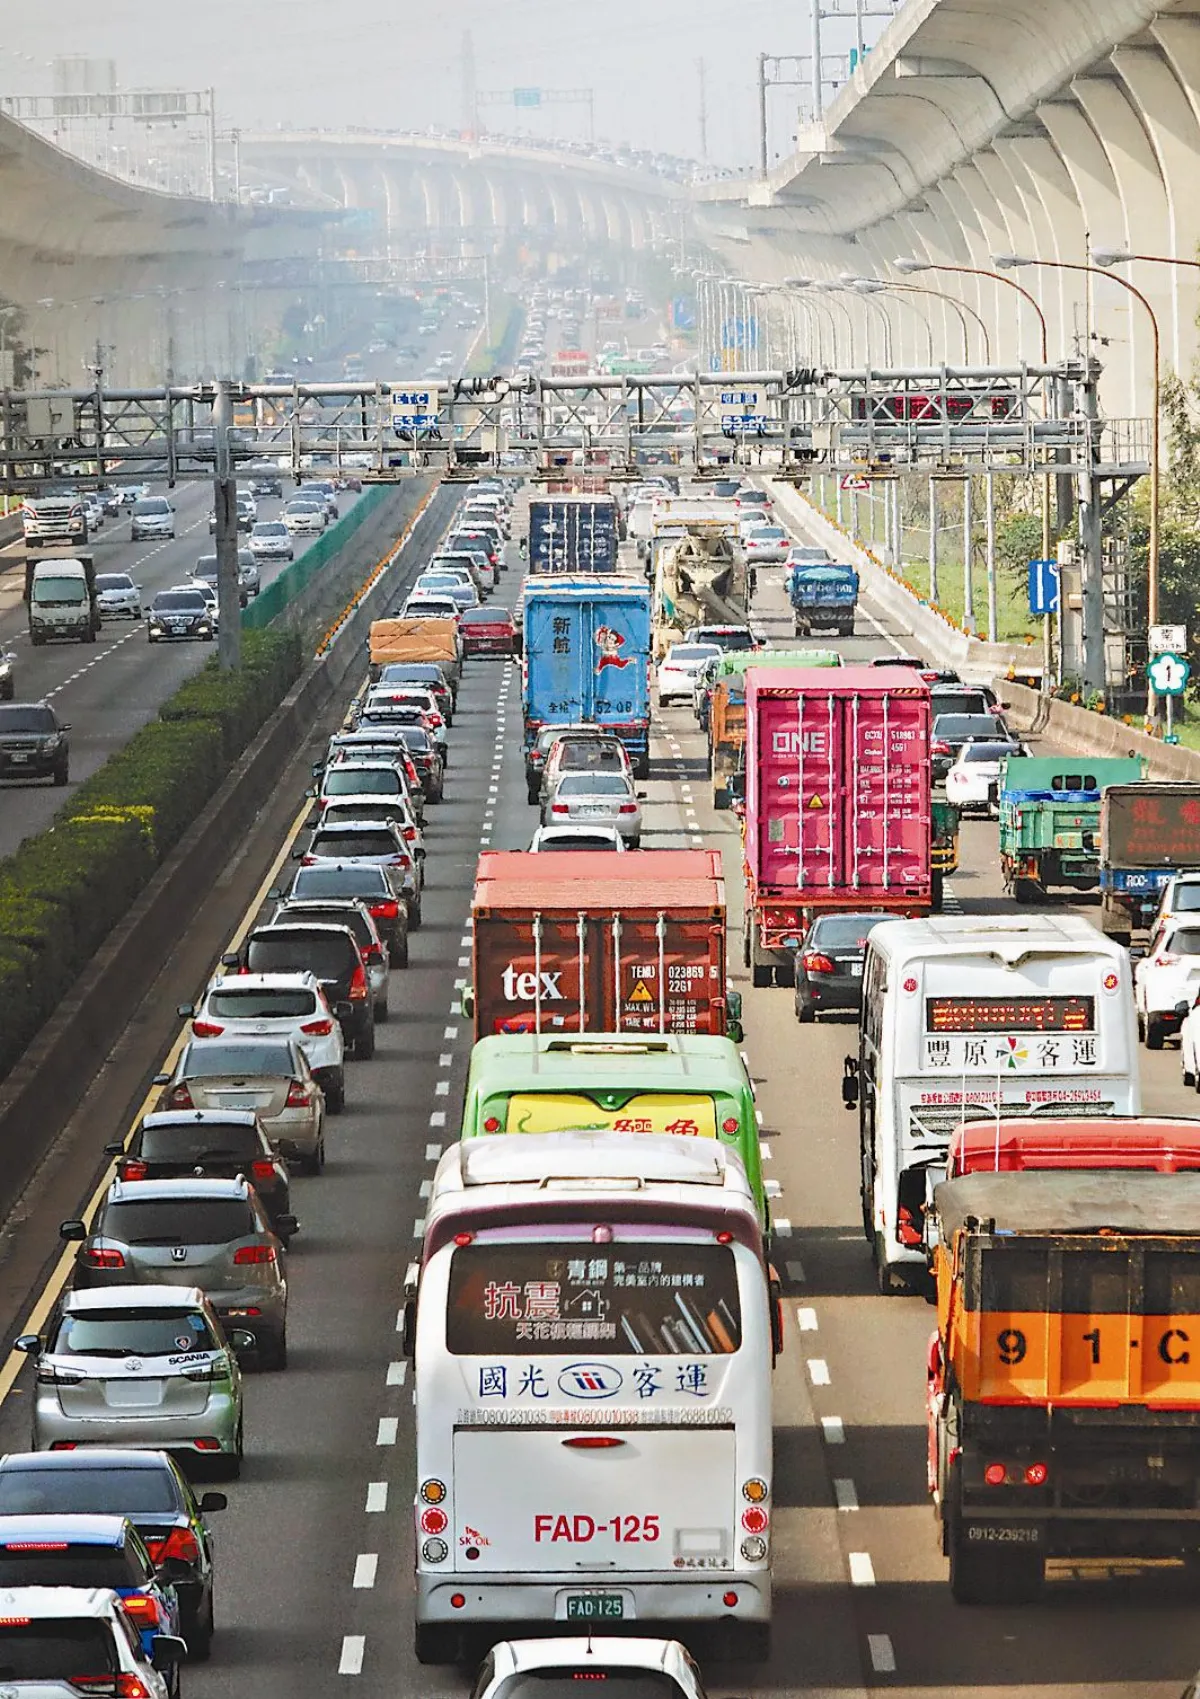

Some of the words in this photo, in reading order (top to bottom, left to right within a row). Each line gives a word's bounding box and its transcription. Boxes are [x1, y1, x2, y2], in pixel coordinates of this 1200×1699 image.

[395, 393, 426, 405] ETC
[1166, 664, 1172, 681] 1
[773, 731, 825, 752] ONE
[631, 966, 655, 978] TEMU
[668, 966, 704, 978] 023869
[709, 966, 718, 978] 5
[928, 1039, 988, 1068] 豐原
[1037, 1038, 1097, 1068] 客運
[485, 1281, 561, 1319] 抗震
[168, 1352, 211, 1366] SCANIA
[479, 1364, 549, 1398] 國光
[633, 1362, 710, 1399] 客運
[535, 1515, 660, 1543] FAD-125
[459, 1536, 471, 1546] SK
[475, 1537, 491, 1546] OIL
